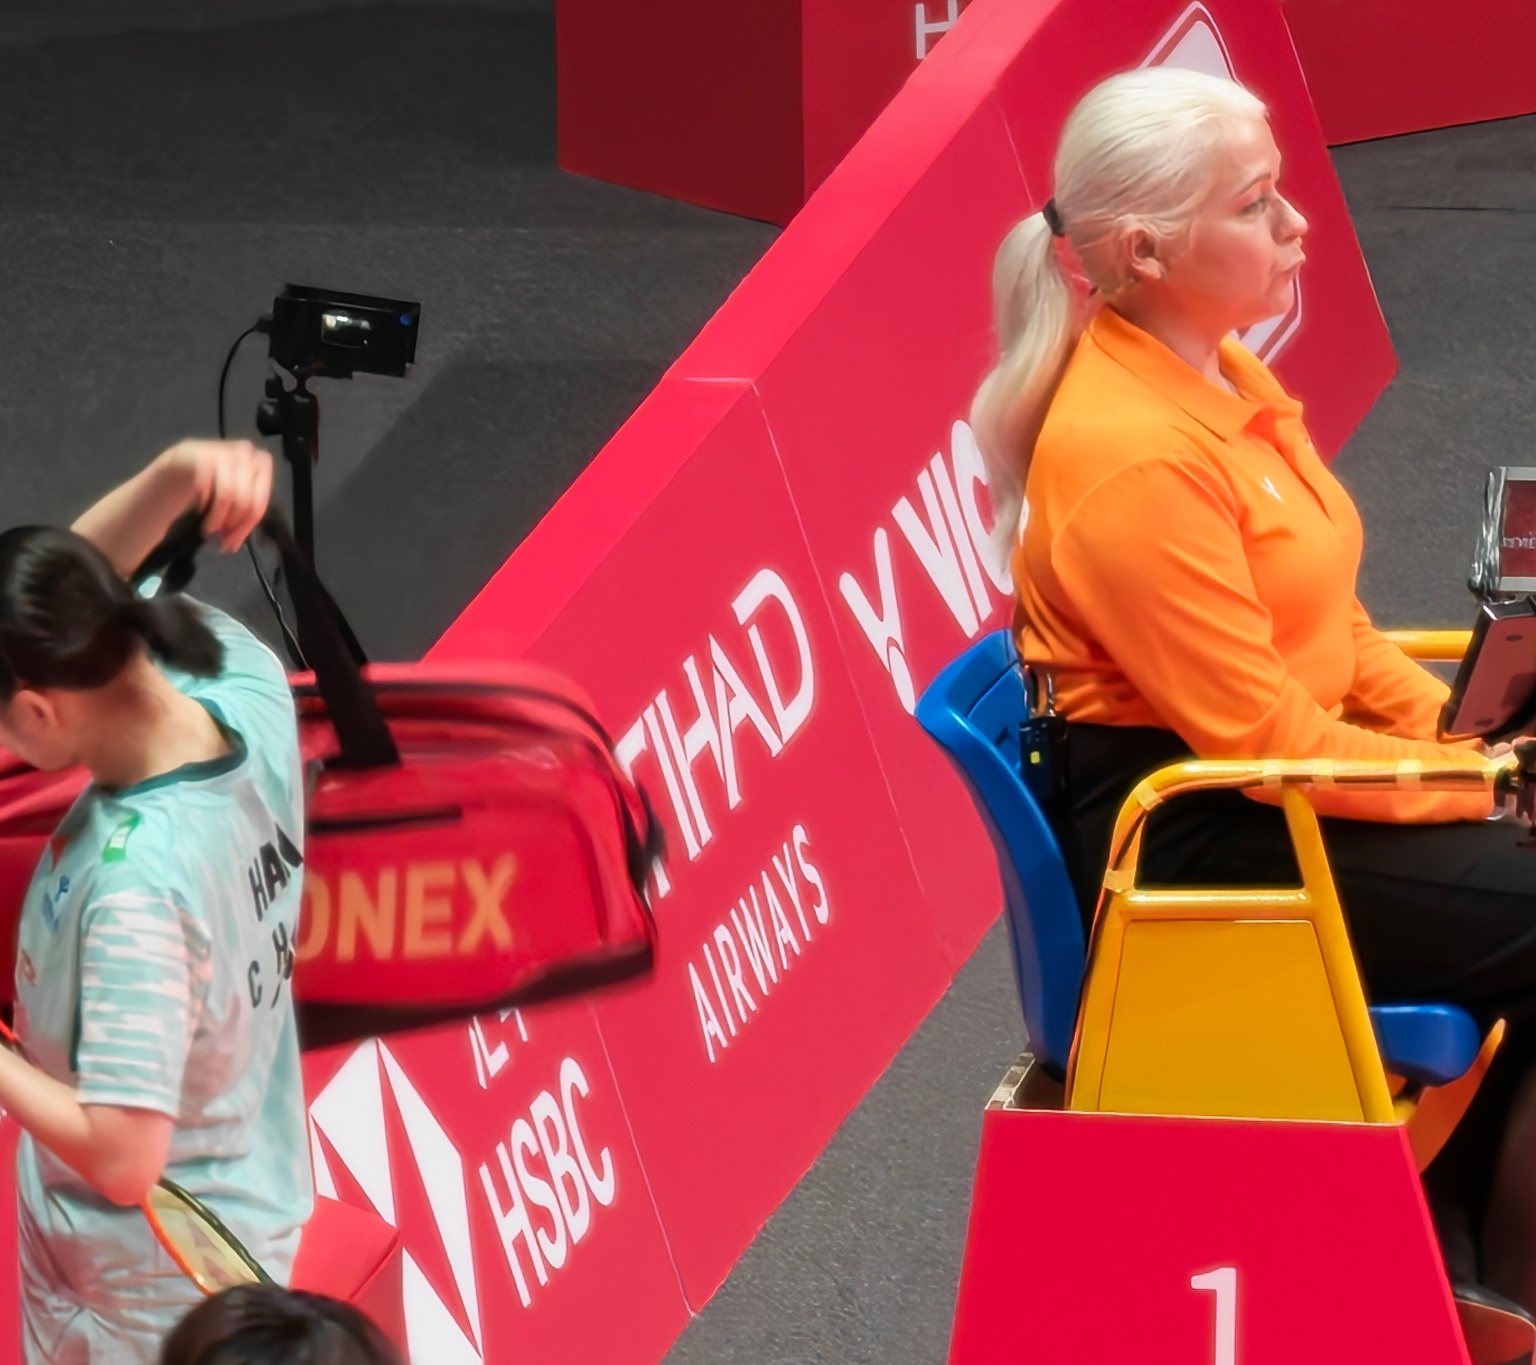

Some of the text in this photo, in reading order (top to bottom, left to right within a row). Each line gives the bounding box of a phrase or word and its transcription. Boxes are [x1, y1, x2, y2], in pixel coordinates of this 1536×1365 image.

[891, 419, 1014, 639] VIC
[614, 568, 815, 900] TIHAD
[296, 852, 521, 963] ONEX
[686, 824, 830, 1064] AIRWAYS
[478, 1056, 615, 1309] HSBC
